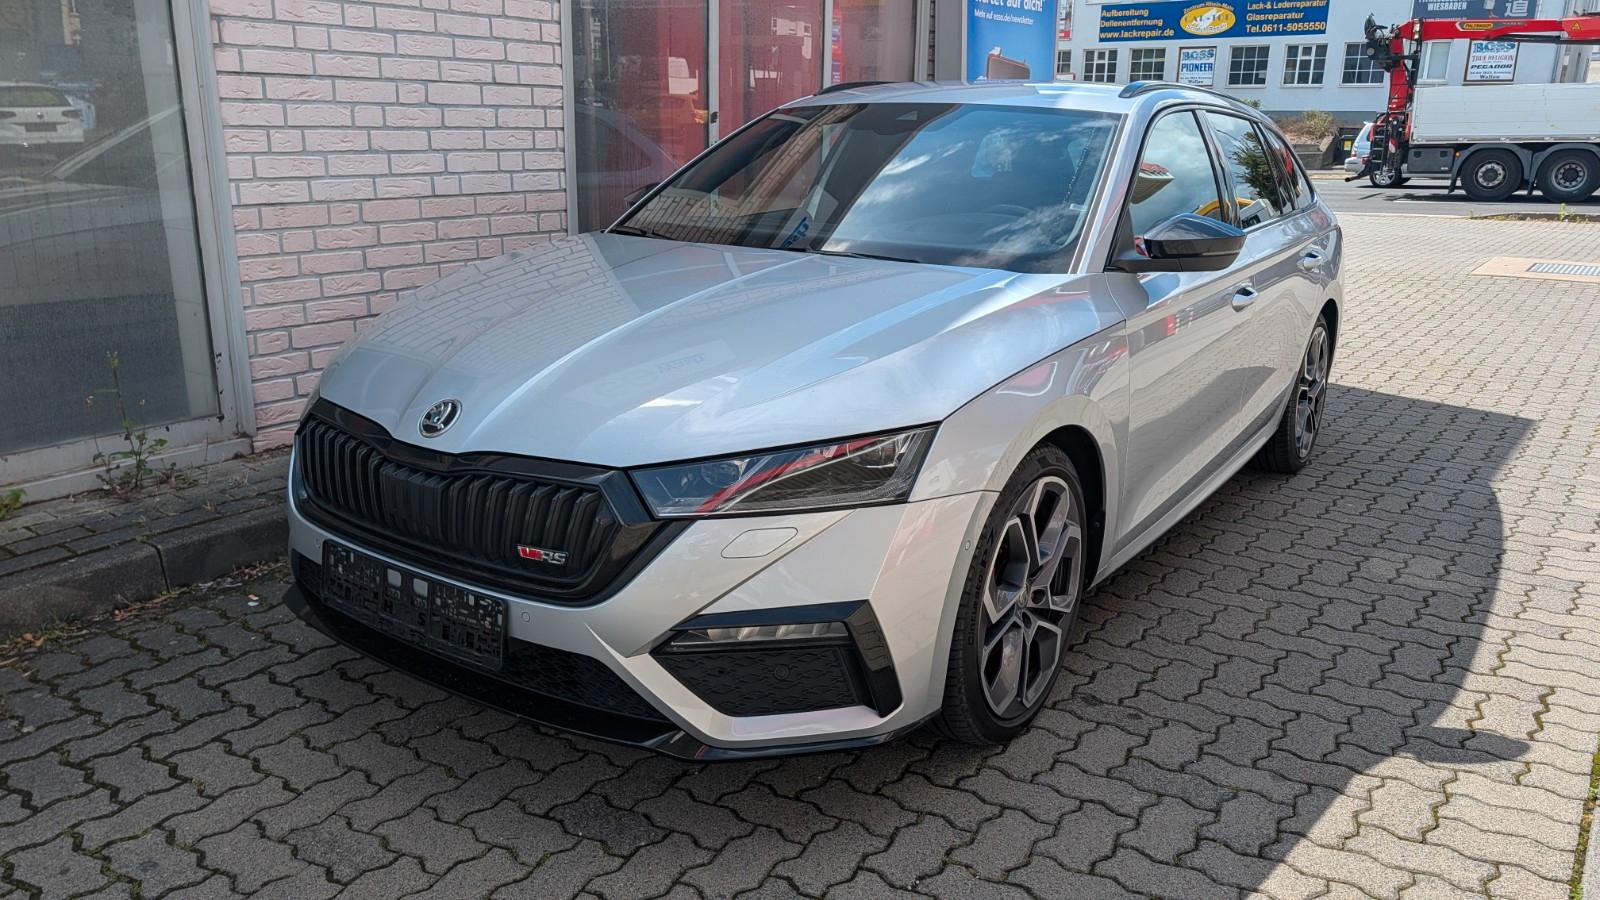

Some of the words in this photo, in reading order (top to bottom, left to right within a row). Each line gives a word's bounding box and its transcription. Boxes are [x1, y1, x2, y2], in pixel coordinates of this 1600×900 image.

[1273, 0, 1327, 9] Lederreparatur
[1427, 2, 1468, 11] WIESBADEN
[974, 8, 986, 18] Mehr
[1101, 8, 1149, 17] Aufbereitung
[1246, 11, 1305, 21] Glasreparatur
[1100, 17, 1163, 28] Dellenentfernung
[1245, 21, 1326, 33] Tel.0611-5055550
[1099, 28, 1175, 39] www.lackrepair.de
[1181, 62, 1213, 72] PIONEER
